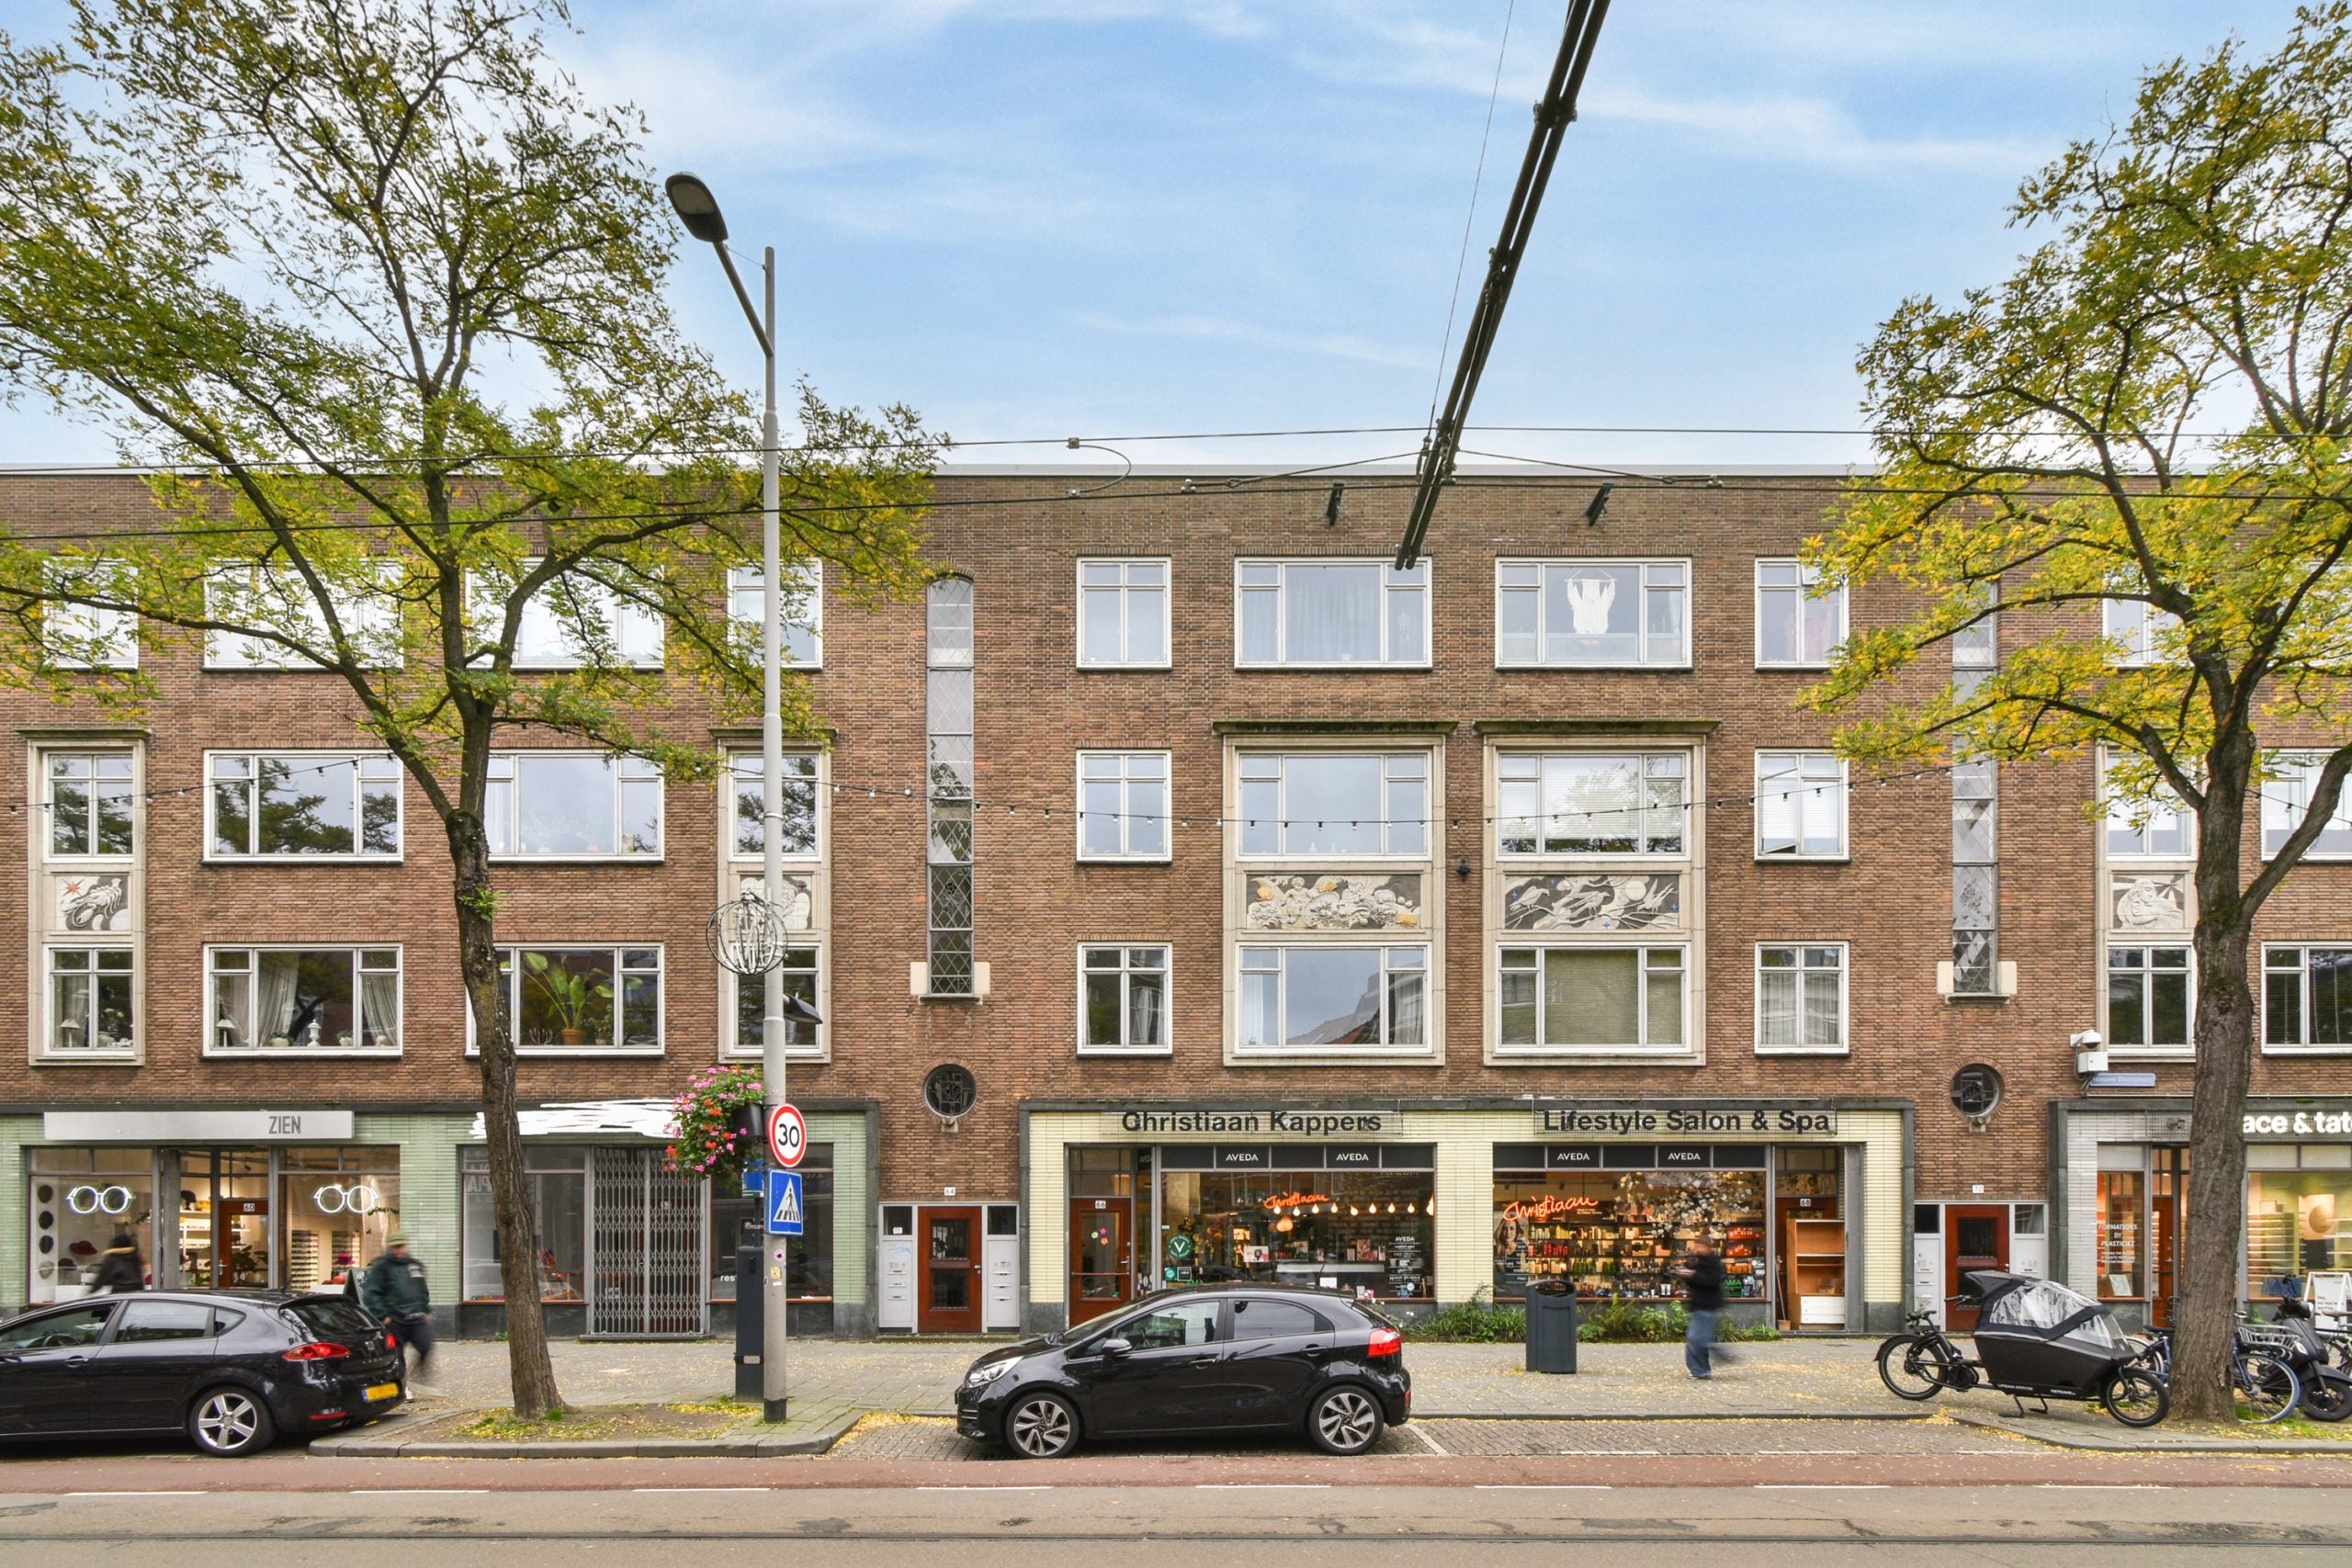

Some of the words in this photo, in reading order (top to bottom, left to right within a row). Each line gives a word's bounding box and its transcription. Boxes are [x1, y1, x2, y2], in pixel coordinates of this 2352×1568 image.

[269, 1116, 301, 1134] ZIEN
[778, 1122, 799, 1148] 30
[1122, 1111, 1259, 1132] Christiaan
[1270, 1111, 1382, 1136] Kappers
[1544, 1110, 1657, 1135] Lifestyle
[1667, 1110, 1741, 1131] Salon
[1751, 1110, 1769, 1131] &
[1778, 1110, 1829, 1134] Spa
[2293, 1112, 2312, 1134] &
[2314, 1111, 2352, 1133] tat
[1503, 1195, 1599, 1220] Christiaan
[720, 1274, 738, 1282] res
